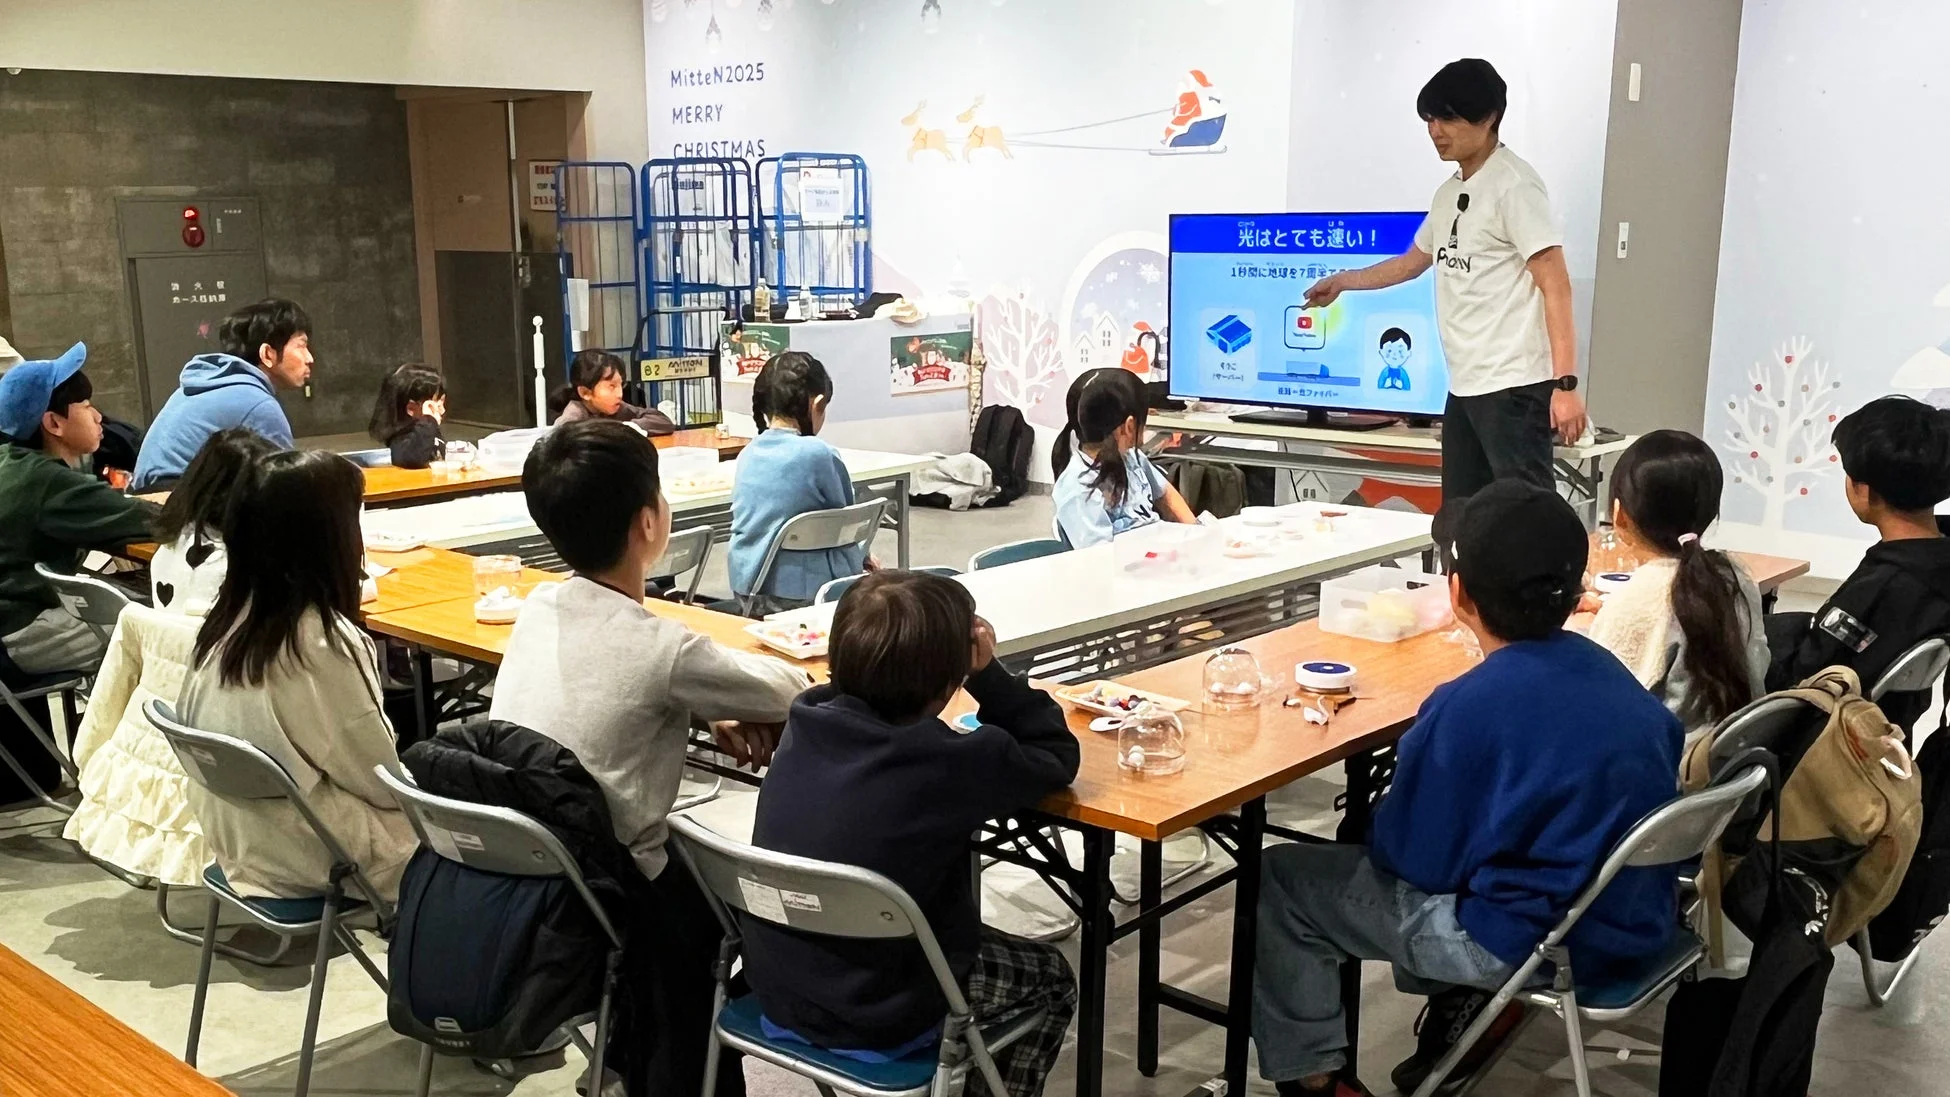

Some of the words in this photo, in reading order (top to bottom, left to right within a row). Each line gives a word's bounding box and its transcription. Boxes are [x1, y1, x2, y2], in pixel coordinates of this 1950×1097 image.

[671, 62, 765, 88] MitteN2025
[672, 104, 723, 124] MERRY
[673, 139, 766, 159] CHRISTMAS
